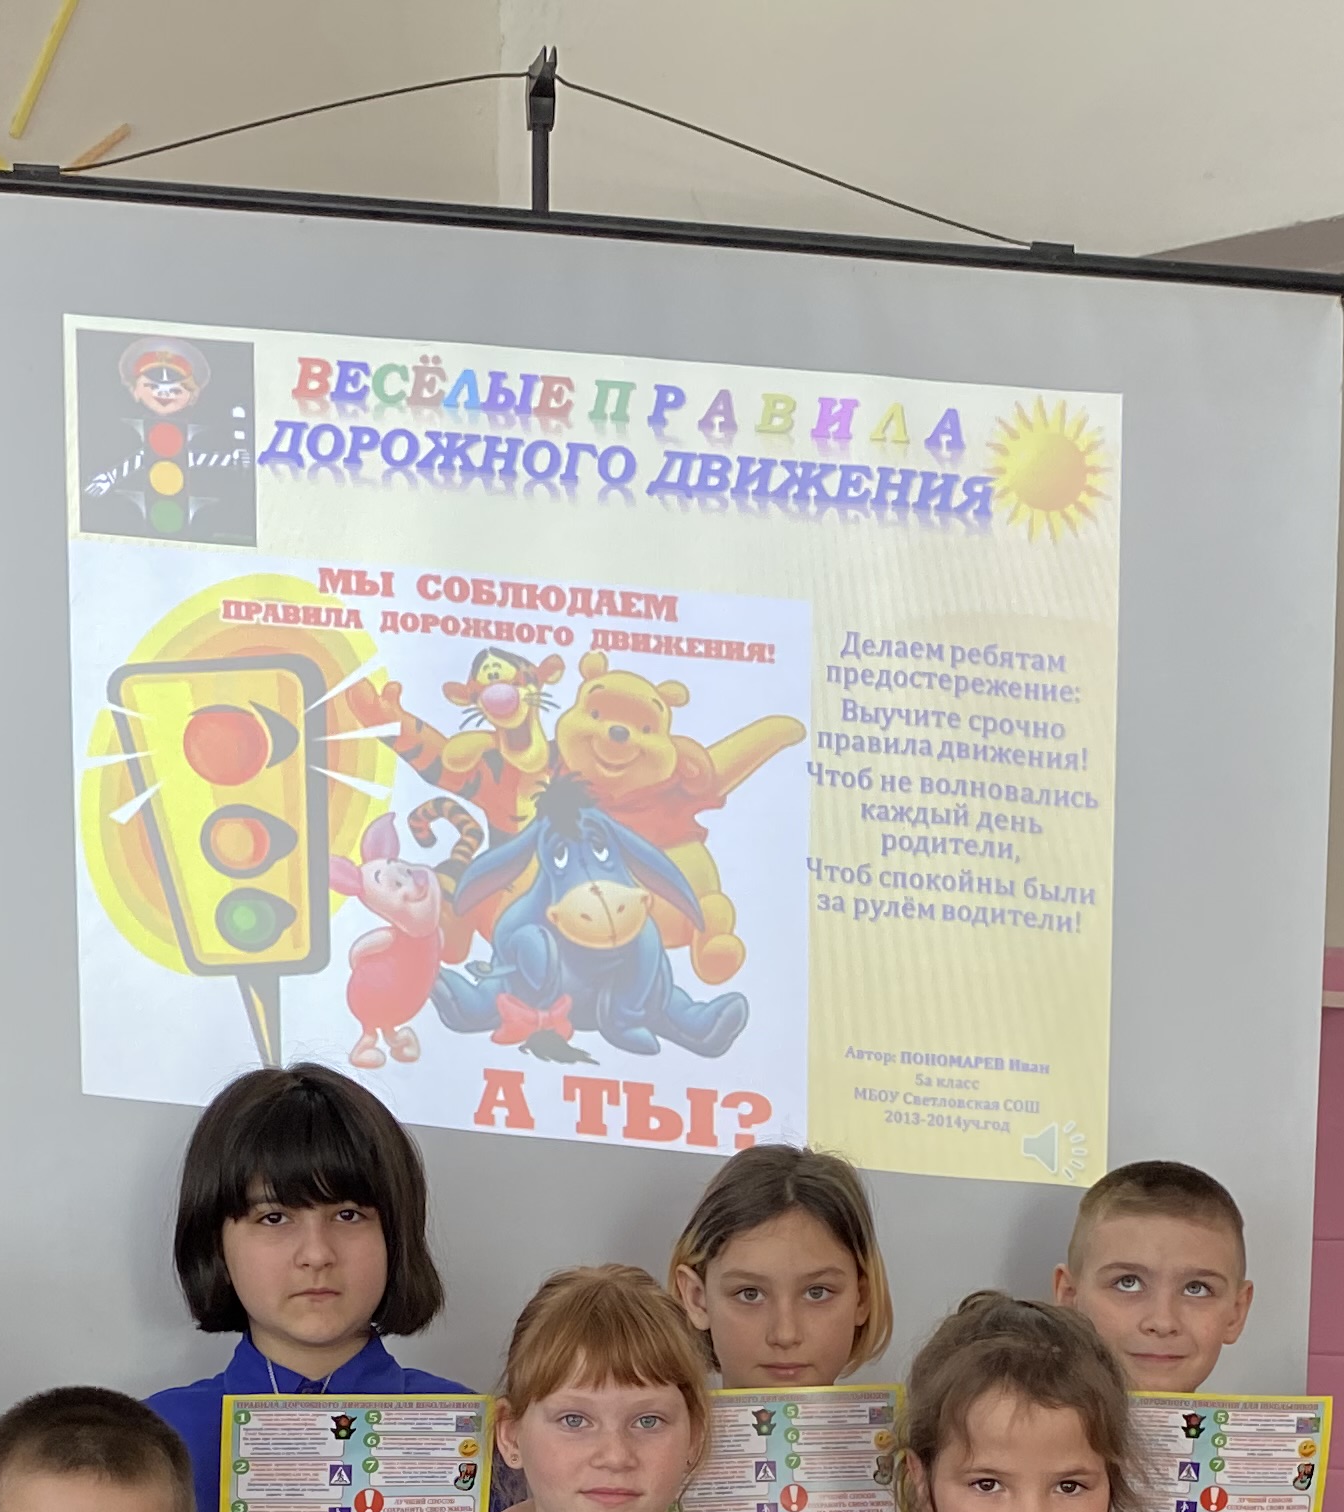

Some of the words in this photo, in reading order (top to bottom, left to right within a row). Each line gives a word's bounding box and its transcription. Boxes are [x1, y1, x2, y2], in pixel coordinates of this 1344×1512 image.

[292, 354, 575, 417] ВЕСЁЛЫЕ
[258, 420, 637, 485] ДОРОЖНОГО
[646, 449, 997, 516] ДВИЖЕНИЯ
[318, 567, 395, 599] МЫ
[416, 573, 679, 623] СОБЛЮДАЕМ
[222, 600, 363, 629] ПРАВИЛА
[379, 612, 574, 648] ДОРОЖНОГО
[590, 630, 776, 665] ДВИЖЕНИЯ!
[840, 631, 944, 661] Делаем
[950, 642, 1066, 674] ребятам
[826, 665, 1082, 704] предостережение:
[841, 699, 962, 732] Выучите
[968, 714, 1065, 745] срочно
[817, 730, 933, 762] правила
[938, 743, 1088, 772] движения!
[806, 762, 874, 791] Чтоб
[880, 775, 912, 794] не
[919, 778, 1099, 810] волновались
[860, 802, 969, 828] каждый
[976, 812, 1043, 835] день
[881, 833, 1022, 863] родители,
[806, 858, 873, 886] Чтоб
[879, 868, 1016, 900] спокойны
[1023, 878, 1097, 905] были
[817, 893, 846, 913] за
[853, 894, 935, 923] рулём
[942, 906, 1082, 934] водители!
[845, 1046, 896, 1065] Автор:
[900, 1052, 1004, 1071] ПОНОМАРЕВ
[1008, 1060, 1050, 1074] Иван
[937, 1077, 980, 1090] класс
[473, 1068, 534, 1129] А
[563, 1075, 773, 1150] ТЫ?
[854, 1087, 899, 1103] МБОУ
[903, 1093, 1000, 1111] Светловская
[1003, 1100, 1040, 1113] СОШ
[238, 1413, 247, 1422] 1
[368, 1413, 378, 1422] 5
[786, 1407, 795, 1416] 5
[1216, 1413, 1226, 1422] 5
[367, 1436, 376, 1445] 6
[787, 1430, 796, 1440] 6
[1215, 1437, 1224, 1446] 6
[235, 1462, 247, 1472] 2
[368, 1461, 378, 1470] 7
[789, 1457, 797, 1466] 7
[1213, 1460, 1221, 1469] 7
[235, 1503, 243, 1512] 3
